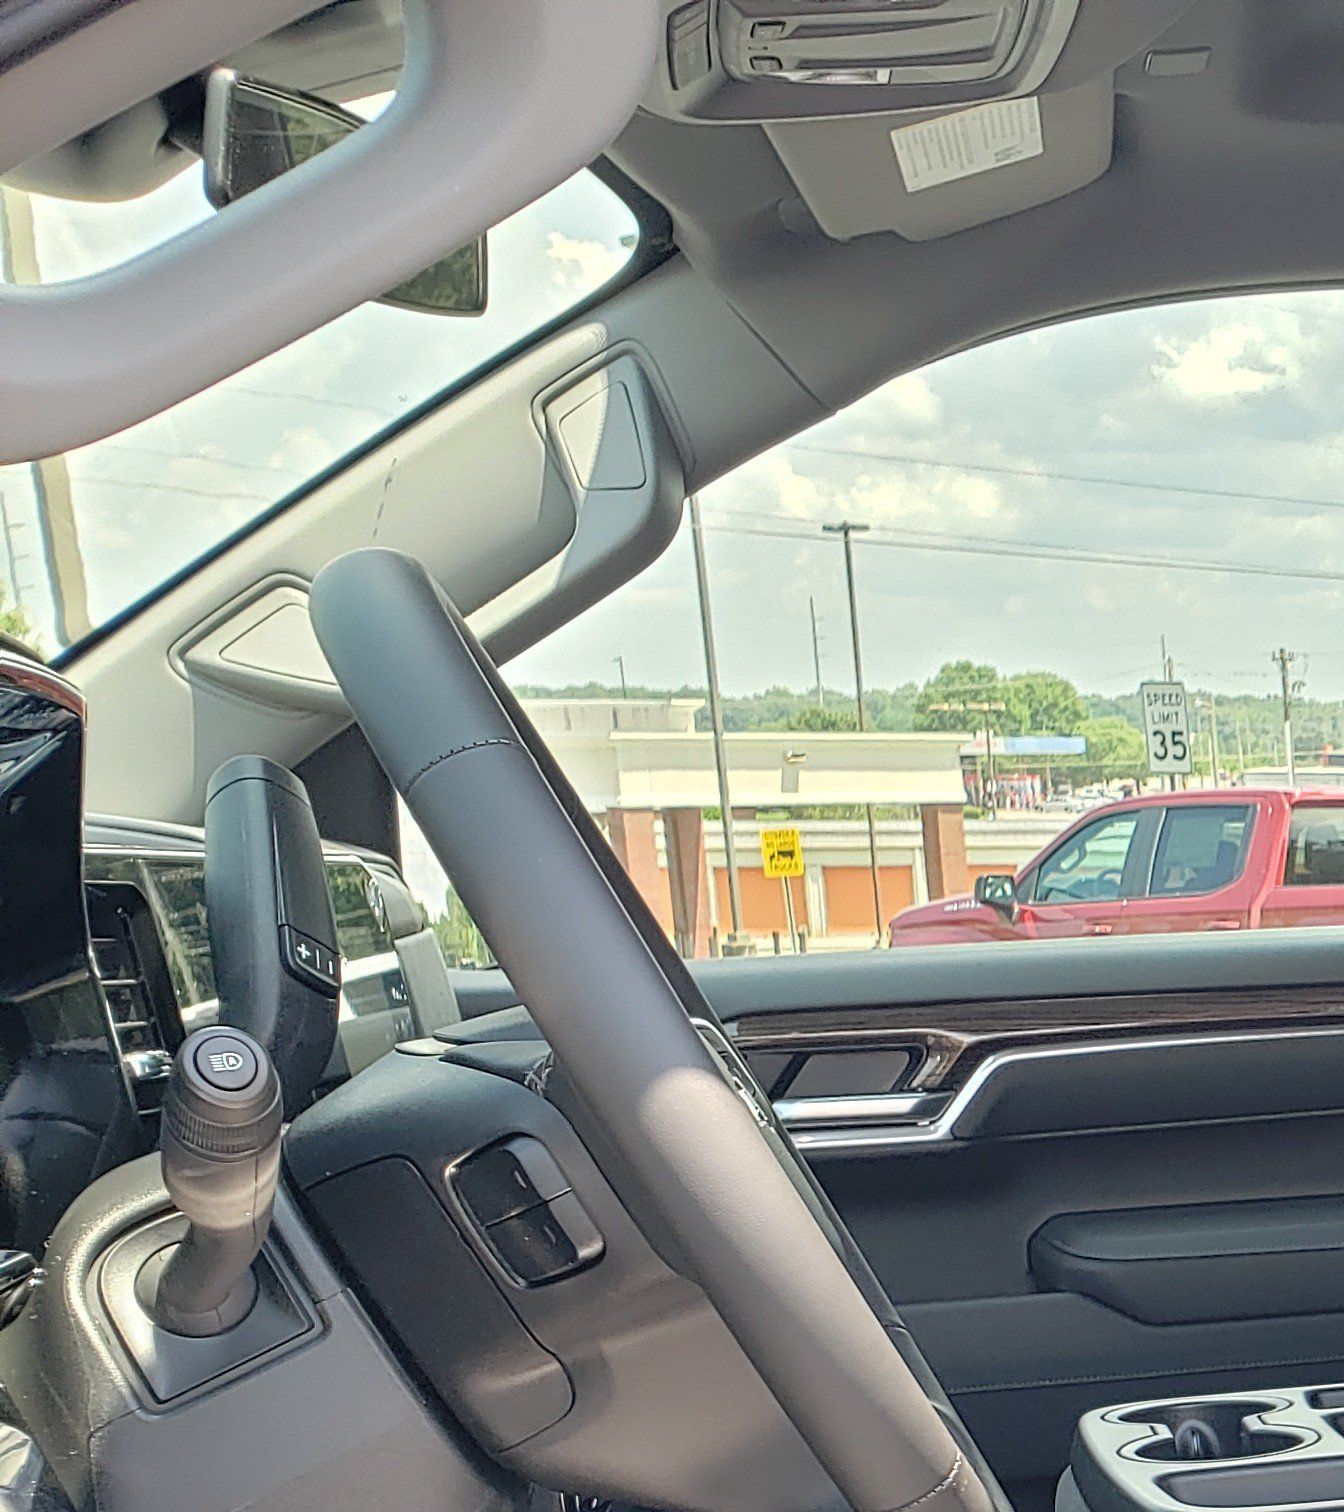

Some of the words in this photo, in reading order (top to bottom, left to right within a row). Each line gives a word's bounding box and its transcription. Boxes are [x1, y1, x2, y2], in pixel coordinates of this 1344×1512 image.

[1146, 692, 1183, 707] SPEED
[1151, 710, 1180, 725] LIMIT
[1152, 729, 1187, 761] 35
